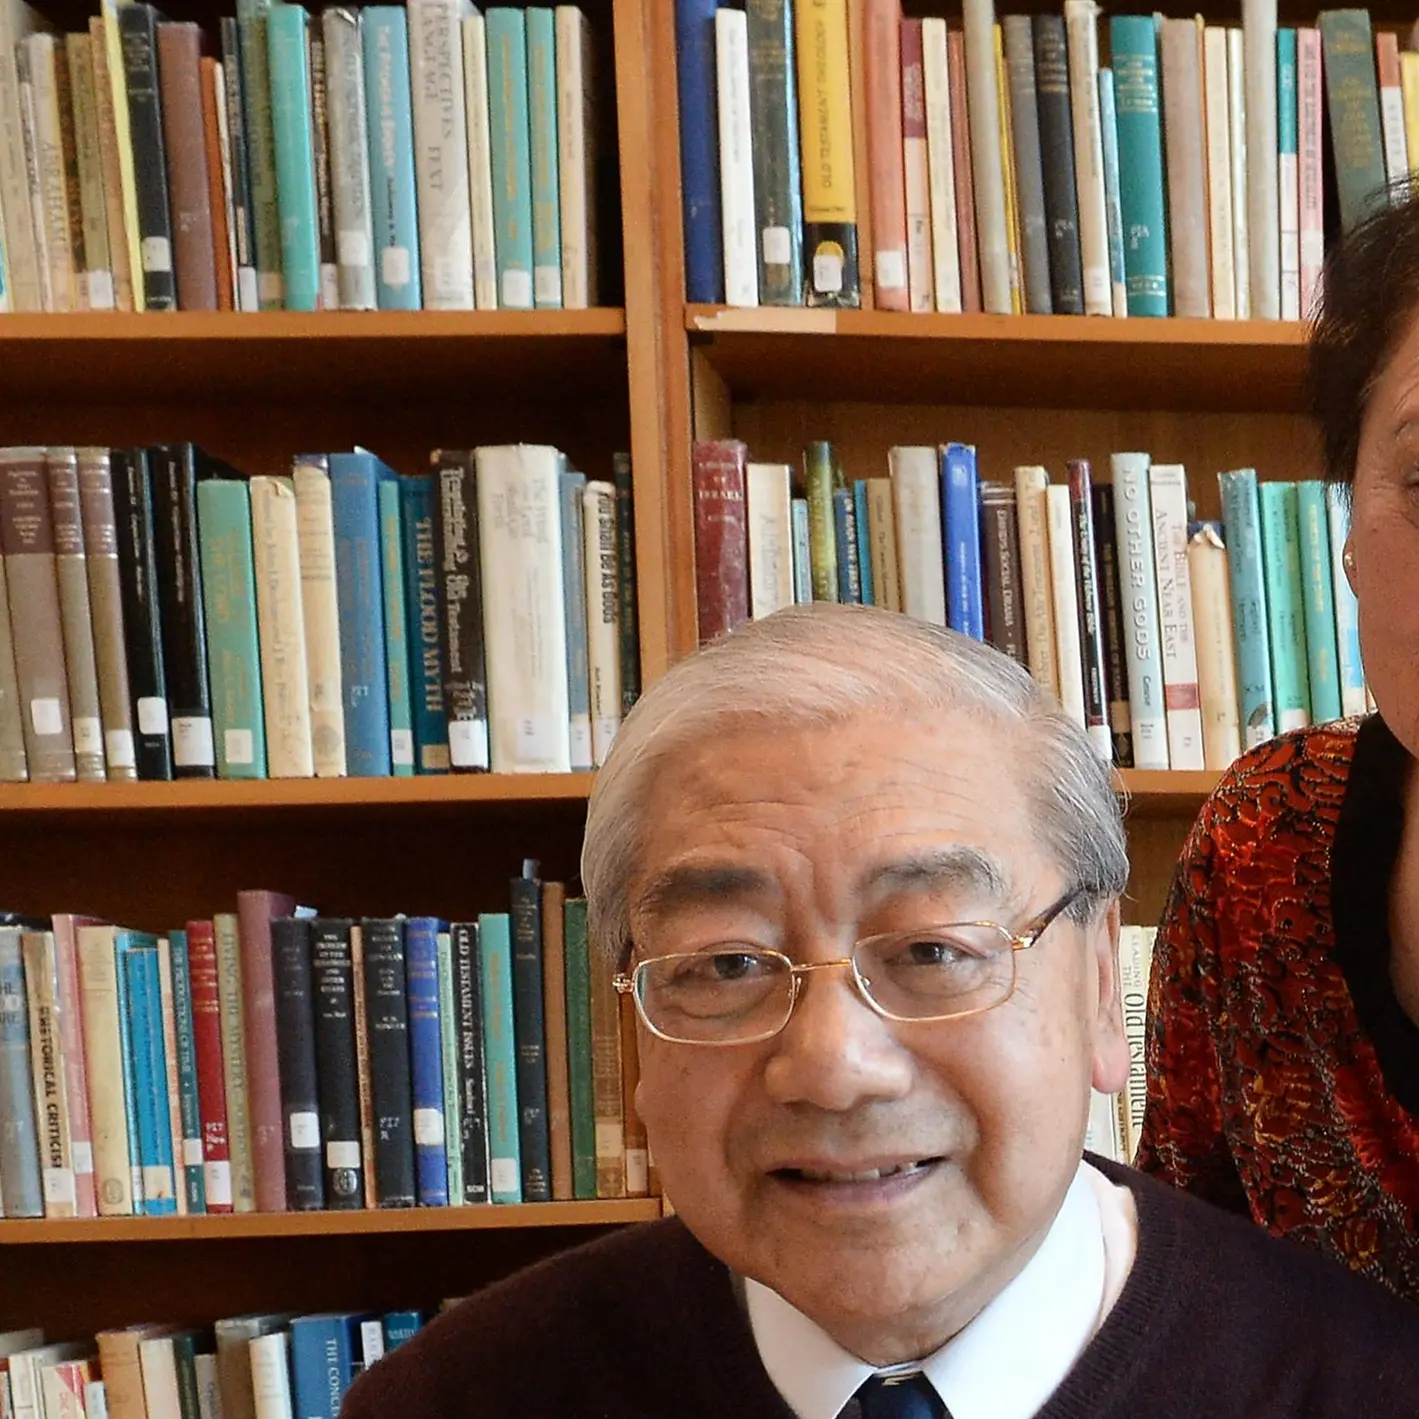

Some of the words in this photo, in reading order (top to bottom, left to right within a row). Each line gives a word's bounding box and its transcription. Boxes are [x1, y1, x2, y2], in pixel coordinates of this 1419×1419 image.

[437, 3, 453, 139] PERSPECTIVES
[814, 19, 828, 84] THEOLOGY
[815, 89, 831, 160] TESTAMENT
[427, 146, 444, 191] TEXT
[817, 163, 832, 189] OLD
[43, 142, 68, 243] ABRAHAM
[1123, 469, 1140, 500] NO
[416, 517, 434, 563] THE
[599, 518, 617, 550] Shall
[1126, 509, 1146, 587] OTHER
[1155, 510, 1173, 576] ANCIENT
[601, 554, 617, 568] Be
[602, 573, 617, 588] As
[999, 551, 1012, 585] SOCIAL
[1173, 551, 1189, 587] BIBLE
[418, 568, 439, 642] FLOOD
[602, 591, 619, 623] Gods
[1002, 590, 1015, 626] DRAMA
[1161, 578, 1176, 618] NEAR
[446, 603, 463, 672] Testament
[1131, 596, 1150, 660] GODS
[1164, 623, 1178, 659] EAST
[421, 648, 444, 712] MYTH
[222, 932, 239, 983] LIVING
[460, 930, 471, 954] OLD
[1130, 934, 1142, 987] READING
[461, 960, 474, 1026] TESTAMENT
[1122, 967, 1132, 988] THE
[226, 992, 240, 1016] THE
[1124, 994, 1146, 1027] Old
[39, 1005, 56, 1096] RHETORICAL
[228, 1024, 242, 1089] MYSTERY
[462, 1031, 475, 1069] ISSUES
[325, 1338, 338, 1364] THE
